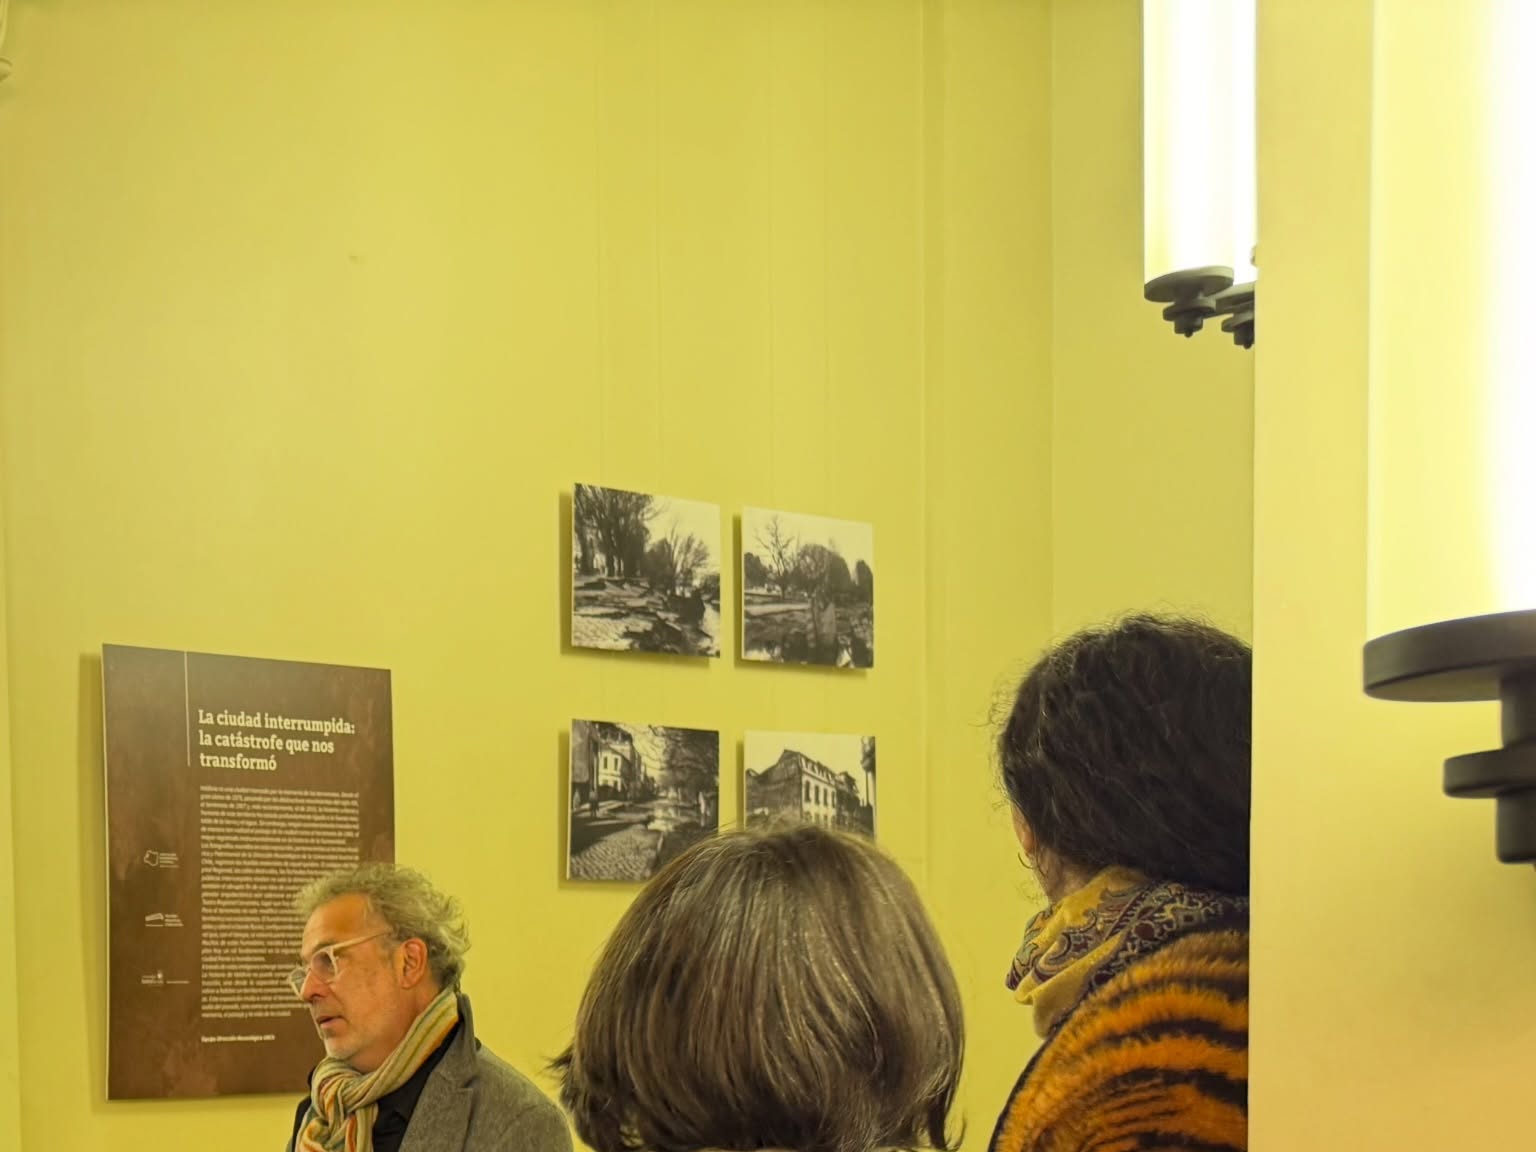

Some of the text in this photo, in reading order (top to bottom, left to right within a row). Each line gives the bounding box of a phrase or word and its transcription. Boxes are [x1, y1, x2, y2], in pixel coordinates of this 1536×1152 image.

[198, 709, 355, 736] La ciudad interrumpida:
[199, 729, 334, 755] la catástrofe que nos
[200, 752, 277, 770] transformó
